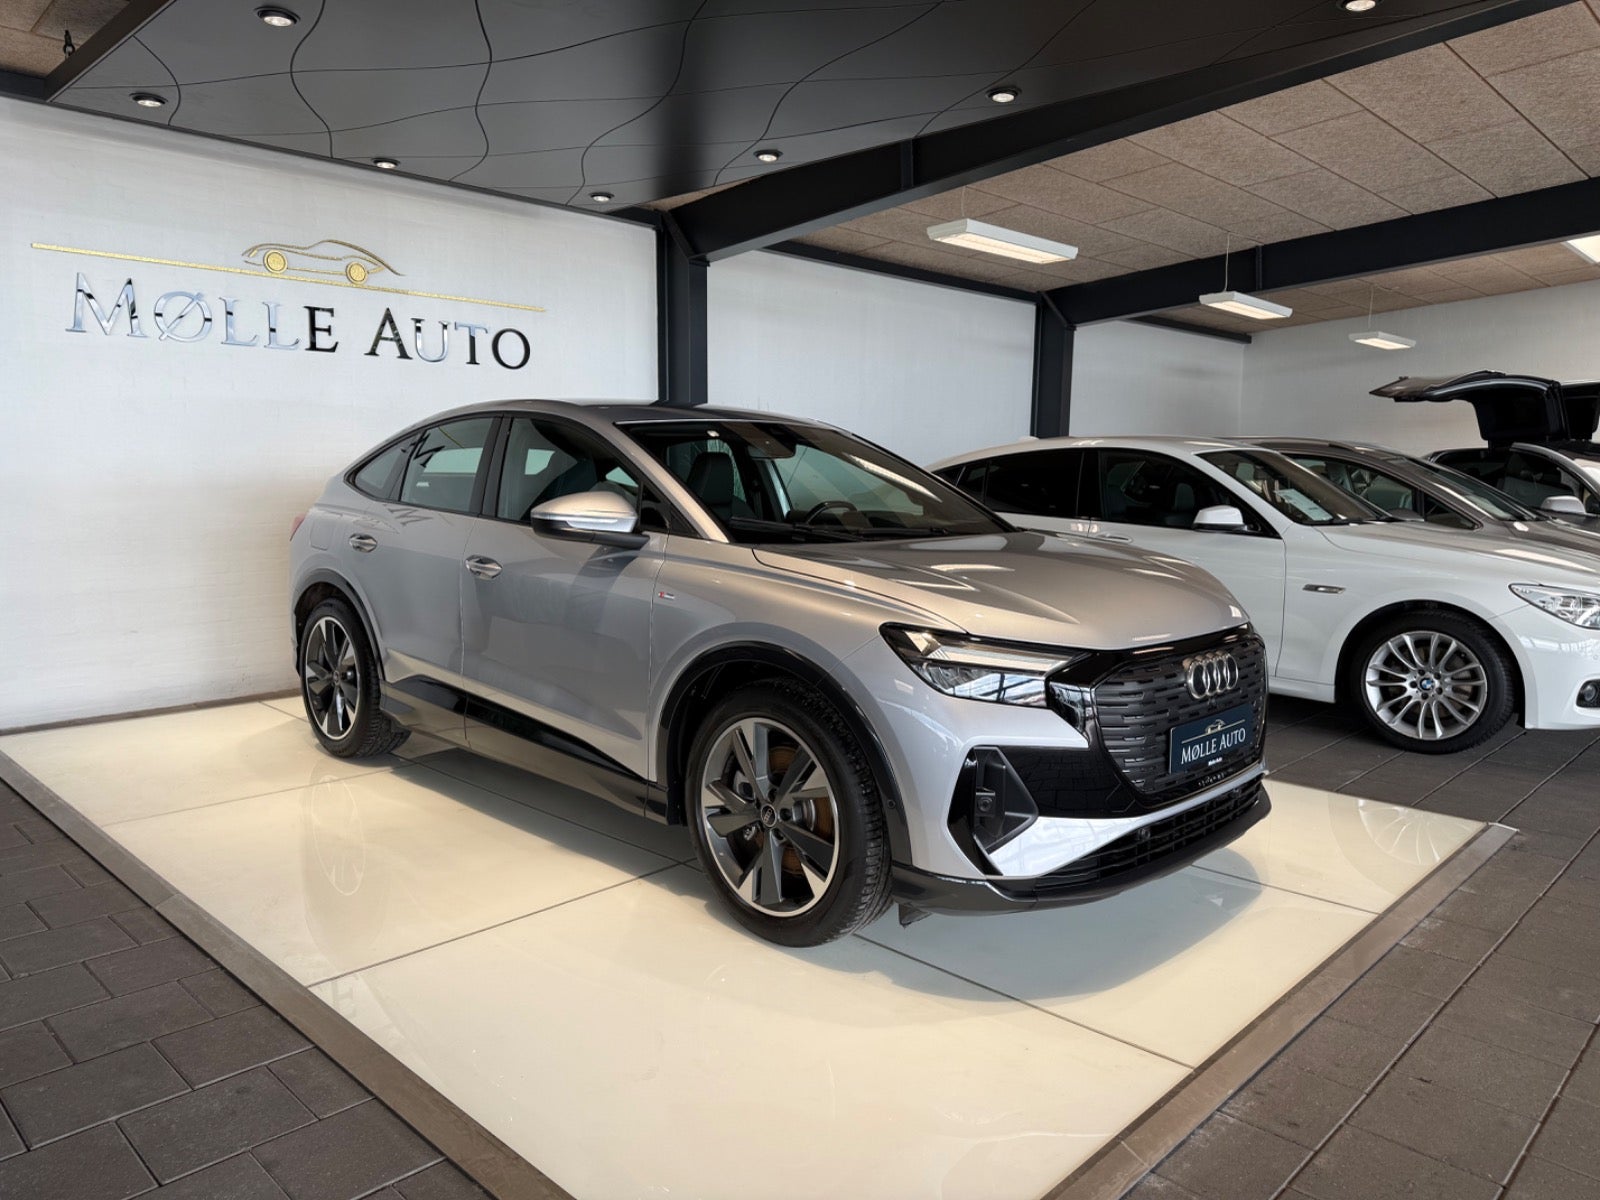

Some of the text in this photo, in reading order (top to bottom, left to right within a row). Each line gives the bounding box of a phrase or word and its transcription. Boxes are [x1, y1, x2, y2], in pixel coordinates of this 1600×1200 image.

[65, 272, 531, 370] MØLLE AUTO
[1181, 727, 1246, 764] MØLLE AUTO
